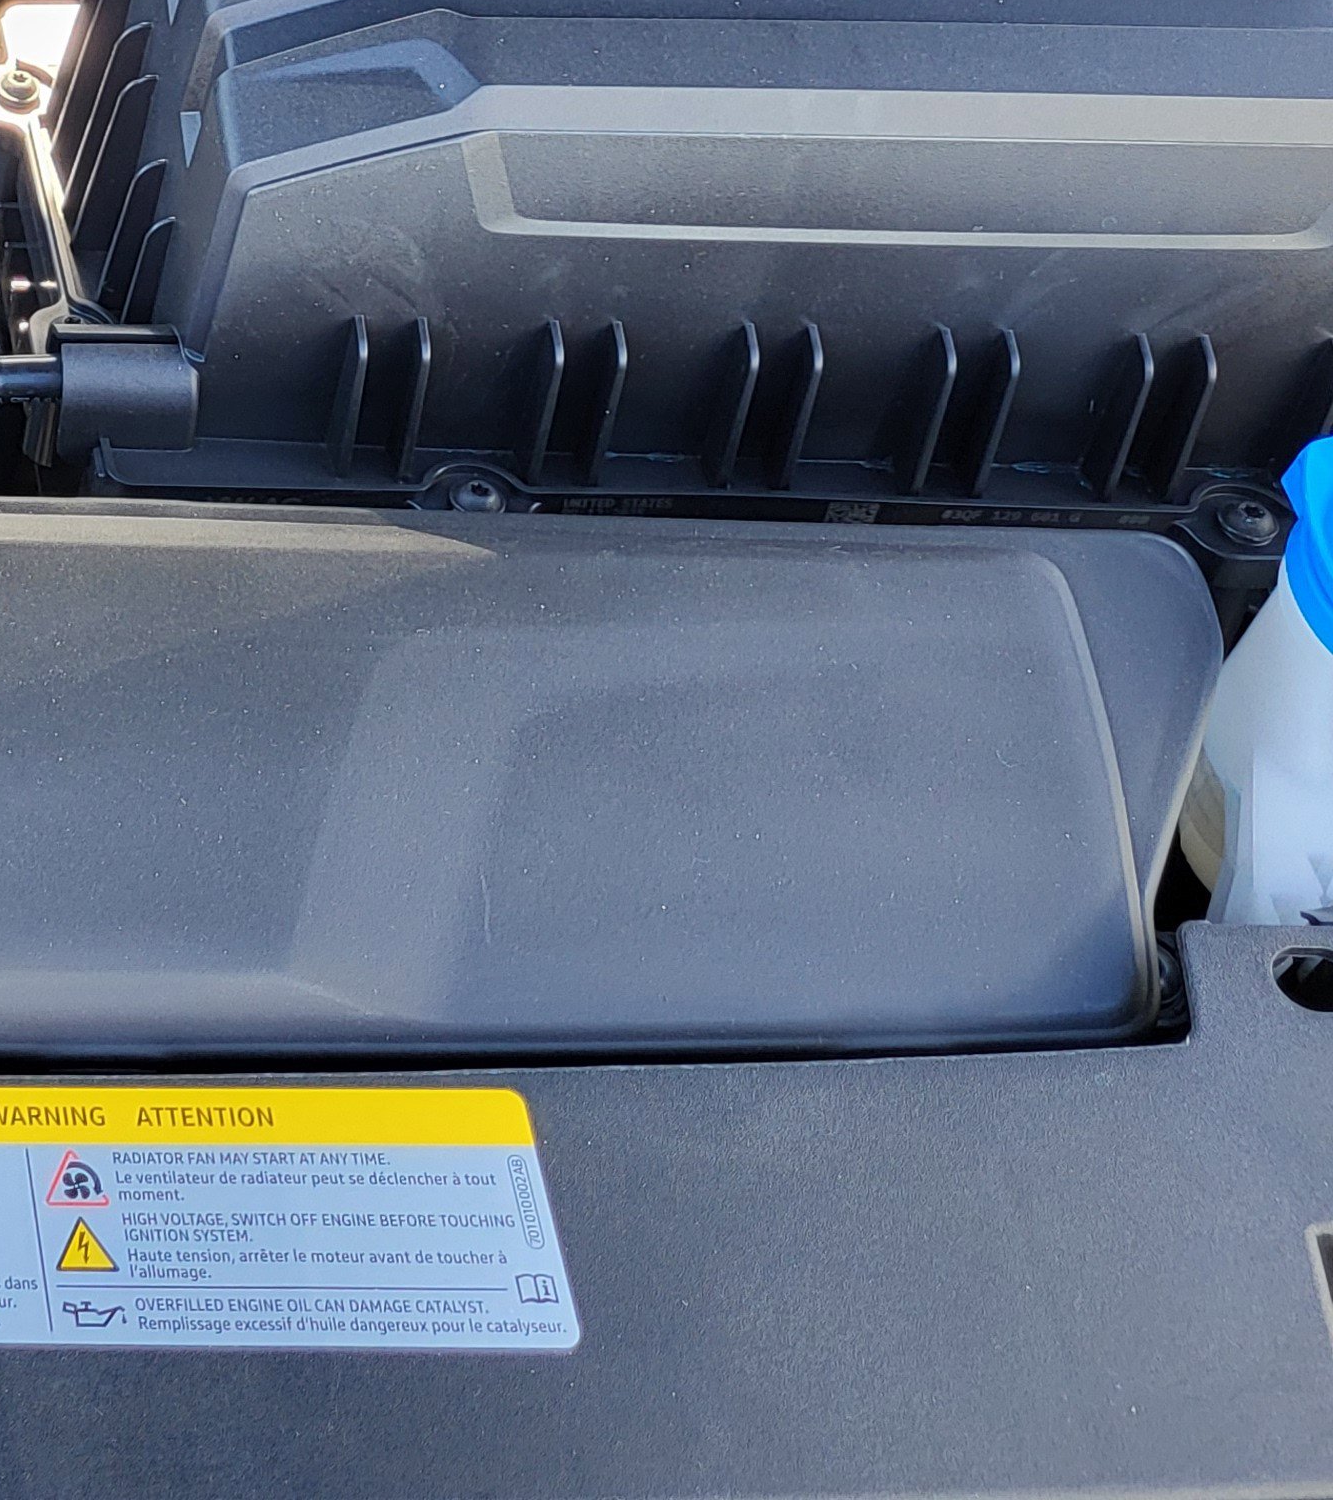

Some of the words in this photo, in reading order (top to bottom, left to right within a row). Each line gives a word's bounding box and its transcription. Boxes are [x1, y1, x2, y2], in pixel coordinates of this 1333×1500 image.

[136, 1106, 274, 1128] ATTENTION
[112, 1151, 185, 1165] RADIATOR
[187, 1151, 216, 1165] FAN
[219, 1152, 249, 1166] MAY
[252, 1151, 296, 1166] START
[319, 1152, 348, 1166] ANY
[350, 1152, 391, 1166] TIME.
[115, 1170, 133, 1184] Le
[135, 1170, 215, 1185] ventilateur
[240, 1170, 308, 1185] radiateur
[368, 1171, 448, 1186] déclencher
[118, 1188, 185, 1202] moment.
[121, 1212, 158, 1226] HIGH
[159, 1212, 229, 1228] VOLTAGE,
[230, 1212, 287, 1227] SWITCH
[321, 1213, 377, 1227] ENGINE
[379, 1213, 437, 1228] BEFORE
[438, 1214, 516, 1228] TOUCHING
[124, 1228, 190, 1243] IGNITION
[192, 1228, 254, 1243] SYSTEM.
[127, 1247, 173, 1263] Haute
[175, 1248, 236, 1265] tension,
[238, 1248, 290, 1263] arrêter
[310, 1250, 365, 1264] moteur
[436, 1250, 494, 1265] toucher
[134, 1297, 224, 1312] OVERFILLED
[227, 1298, 285, 1313] ENGINE
[286, 1298, 313, 1313] OIL
[348, 1299, 413, 1314] DAMAGE
[415, 1299, 489, 1314] CATALYST.
[138, 1315, 232, 1334] Remplissage
[234, 1315, 292, 1332] excessif
[349, 1316, 429, 1336] dangereux
[486, 1318, 567, 1337] catalyseur.
